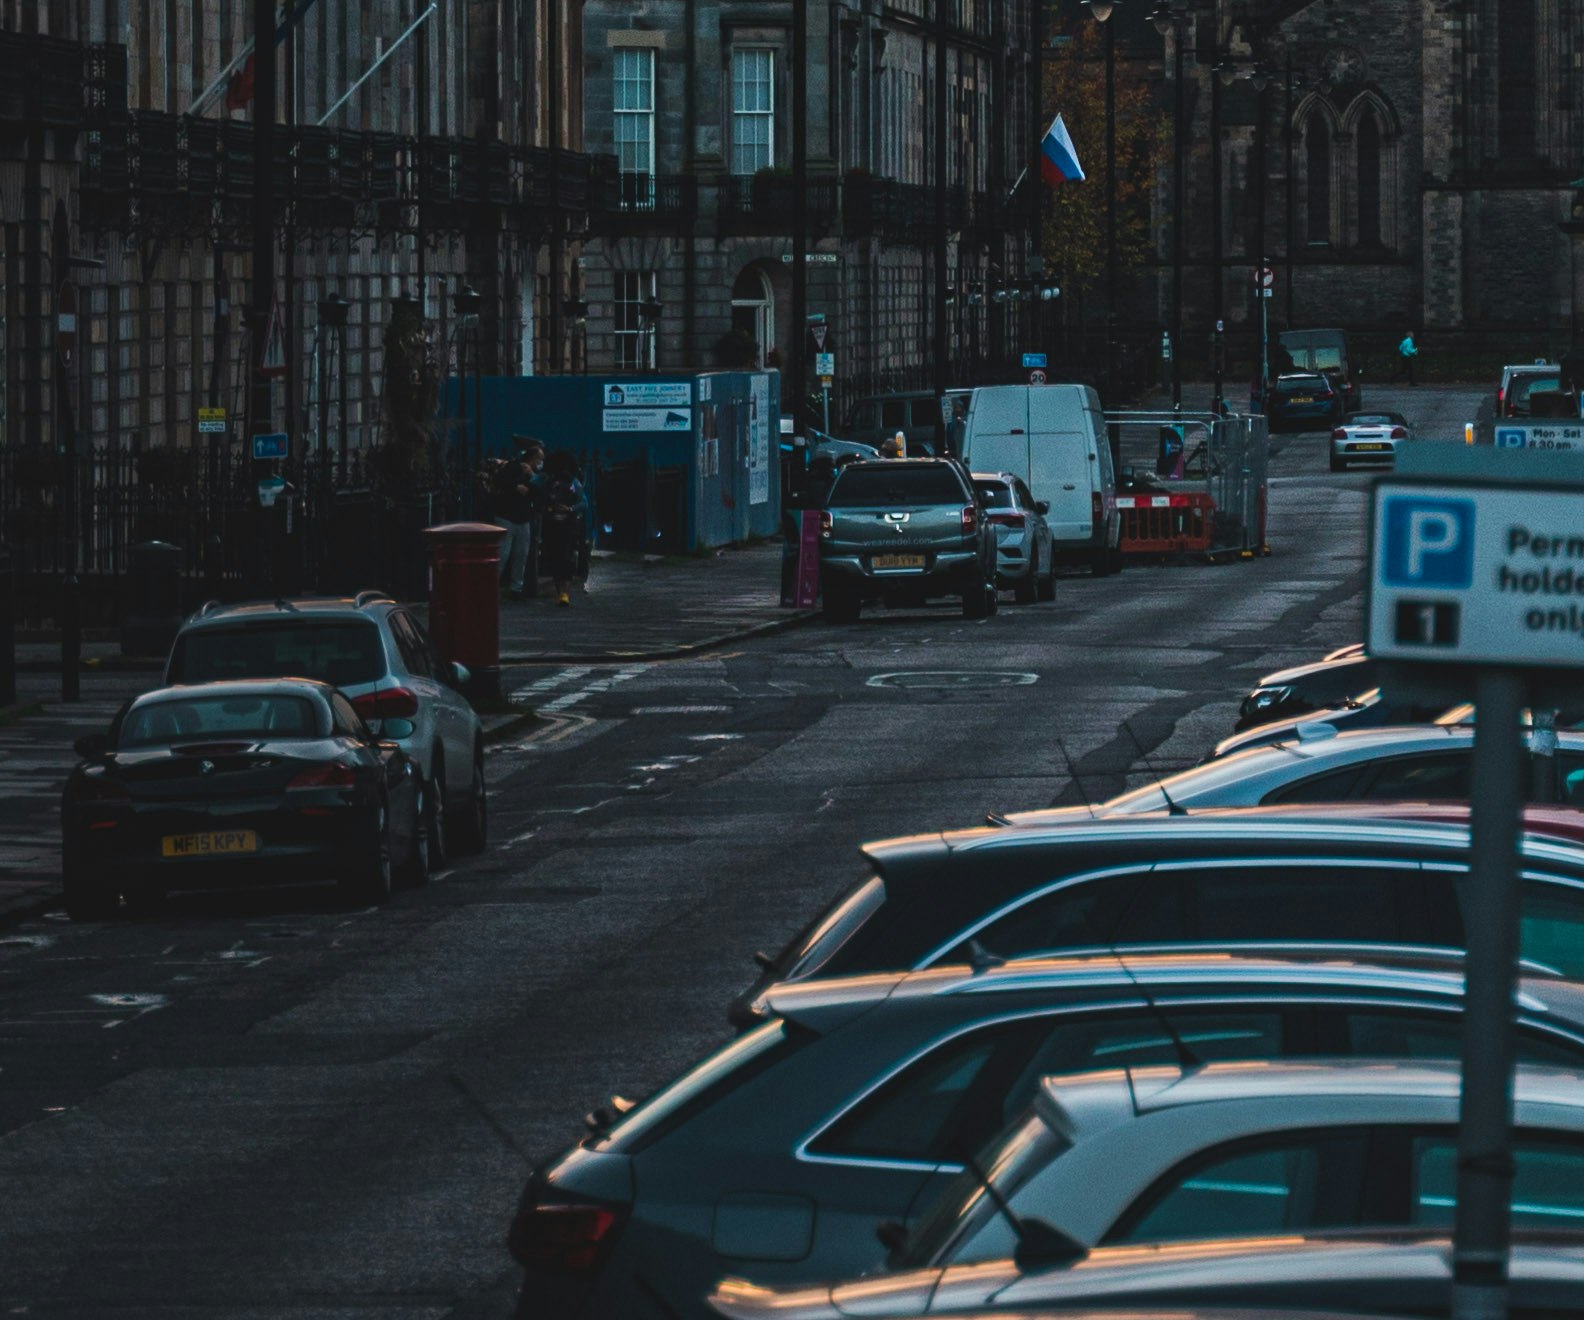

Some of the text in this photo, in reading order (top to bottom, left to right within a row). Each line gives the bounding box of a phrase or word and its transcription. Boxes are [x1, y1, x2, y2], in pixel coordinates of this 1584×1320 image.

[1032, 373, 1045, 383] 20
[1533, 428, 1555, 439] Mon
[1563, 428, 1581, 439] Sat
[1407, 509, 1460, 579] P
[1418, 606, 1437, 643] 1
[214, 831, 246, 849] KPY
